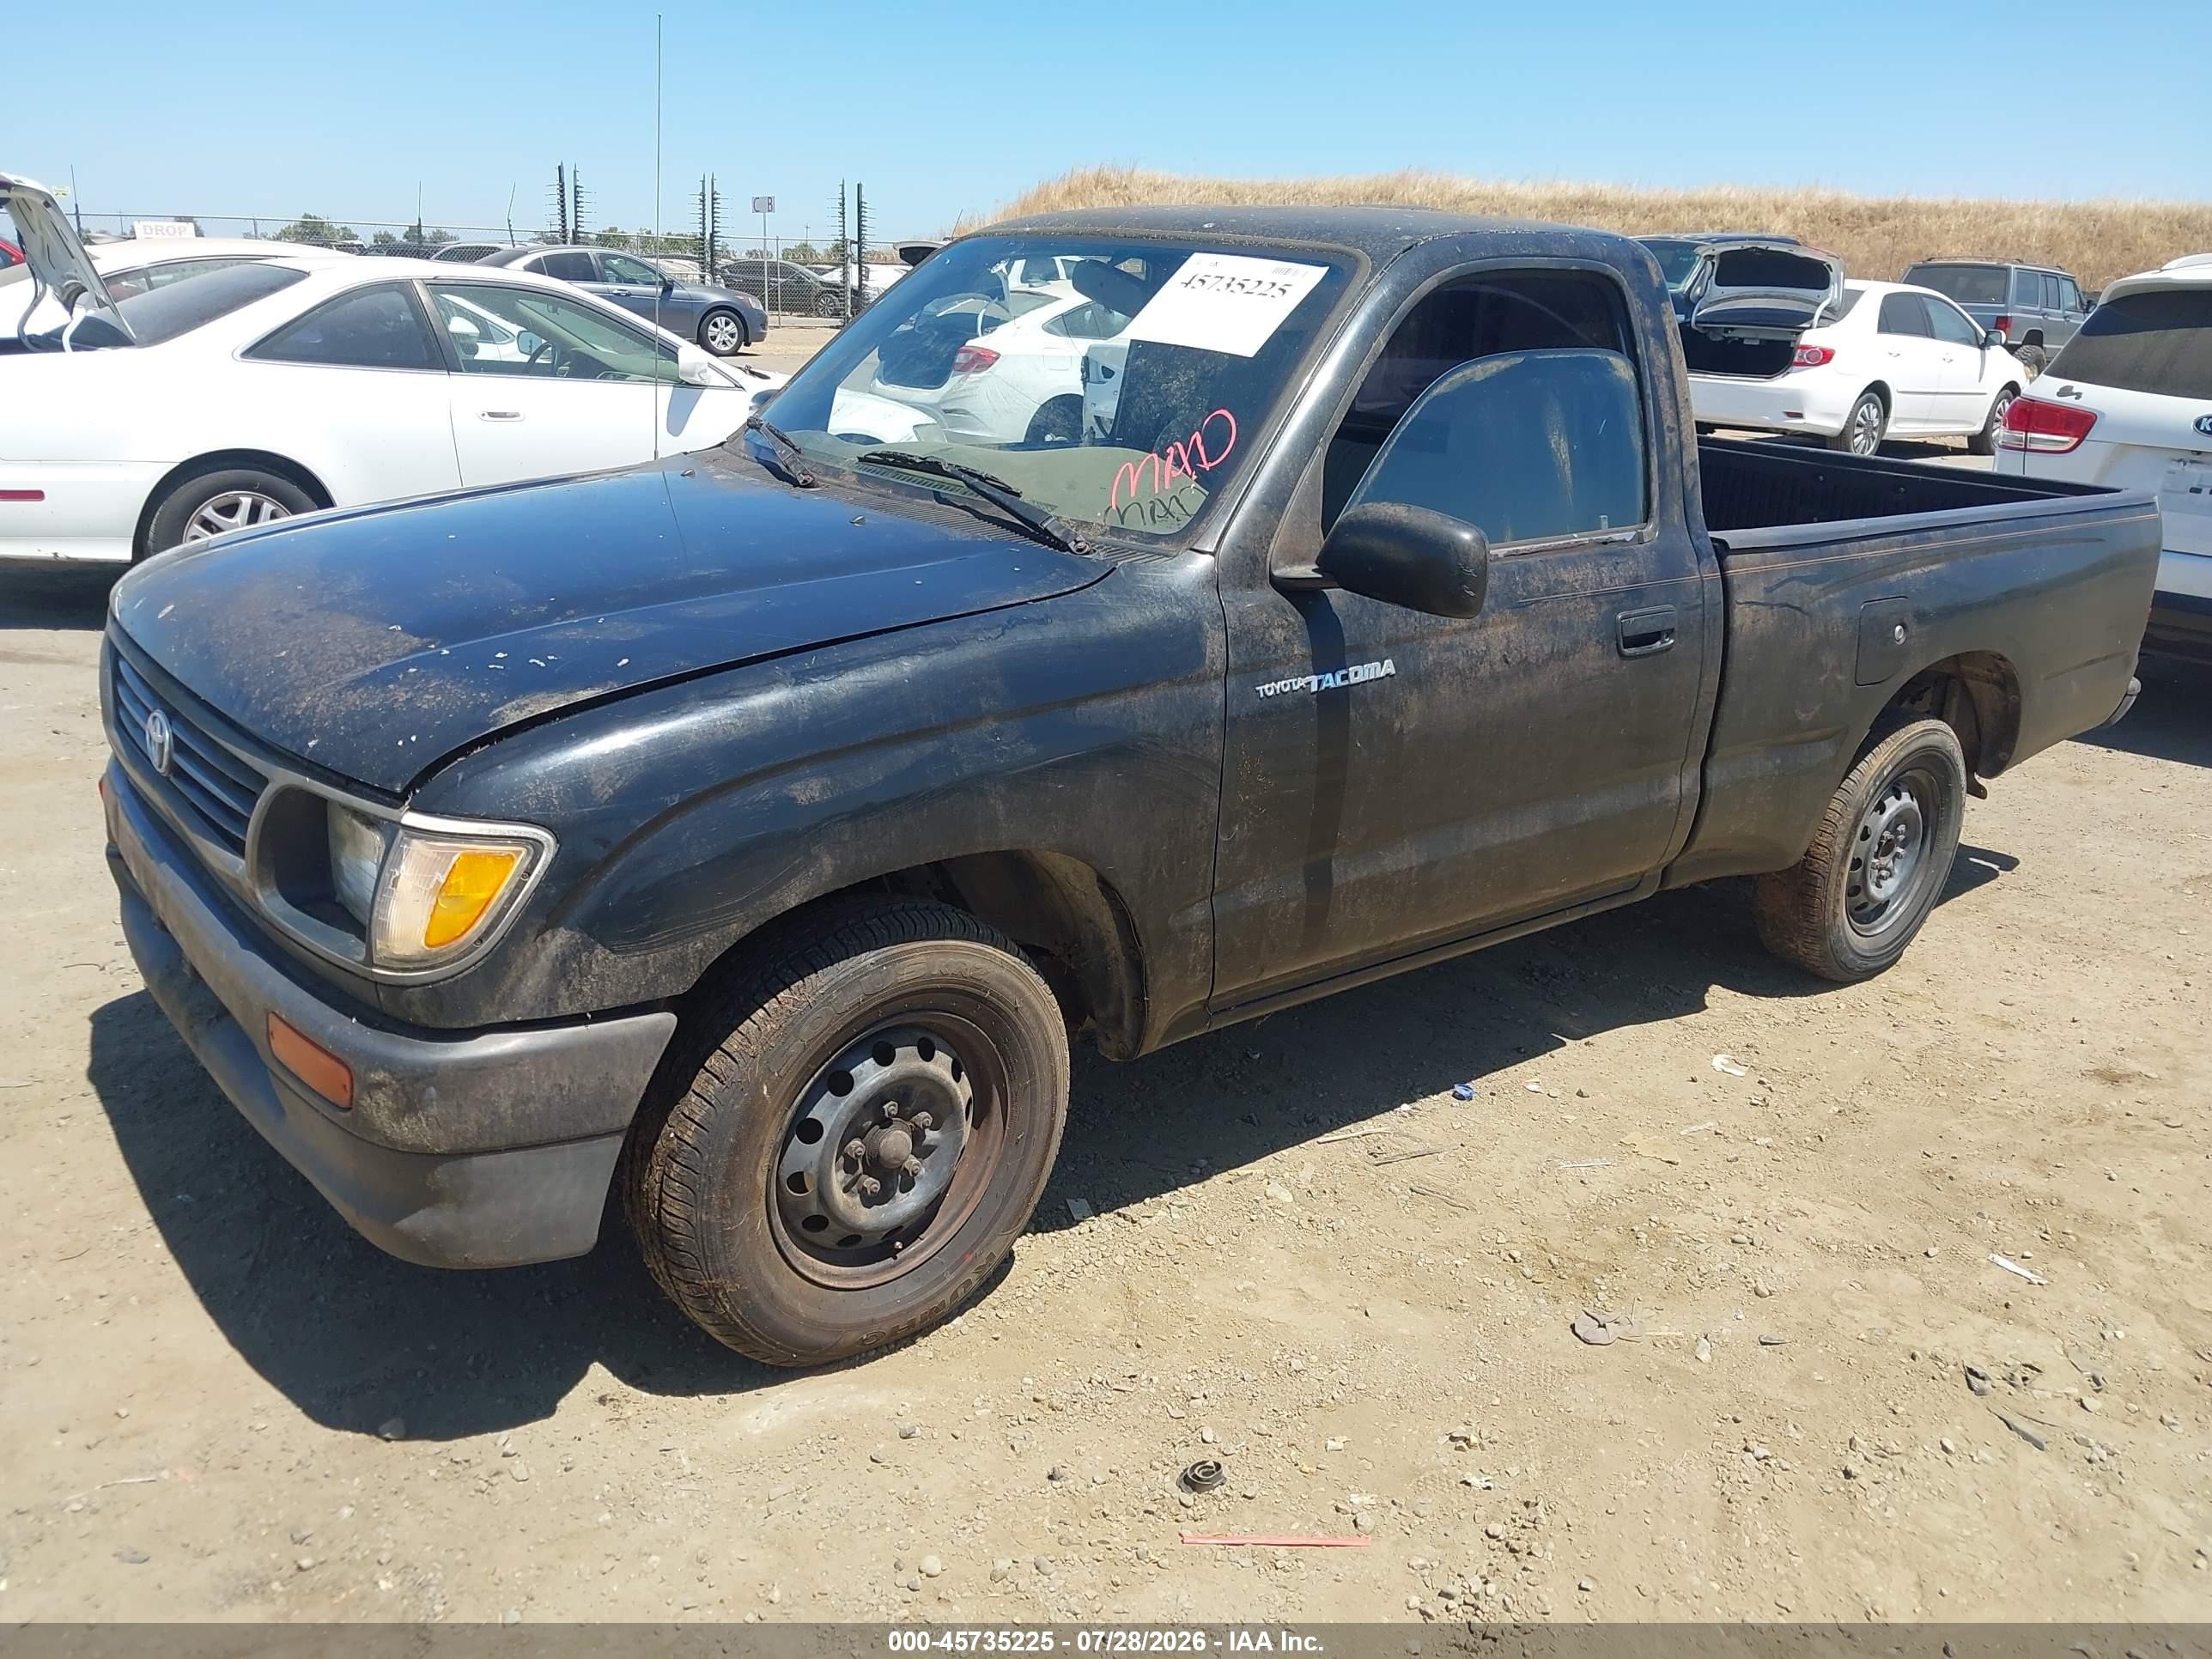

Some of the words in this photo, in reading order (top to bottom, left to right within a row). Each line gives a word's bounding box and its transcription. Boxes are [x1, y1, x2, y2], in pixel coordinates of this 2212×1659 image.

[767, 196, 774, 212] B
[143, 224, 187, 237] DROP
[1181, 273, 1293, 299] 45735225
[1255, 676, 1306, 698] TOYOTA
[1304, 659, 1396, 694] TACOMA
[857, 1251, 998, 1346] KUMHO
